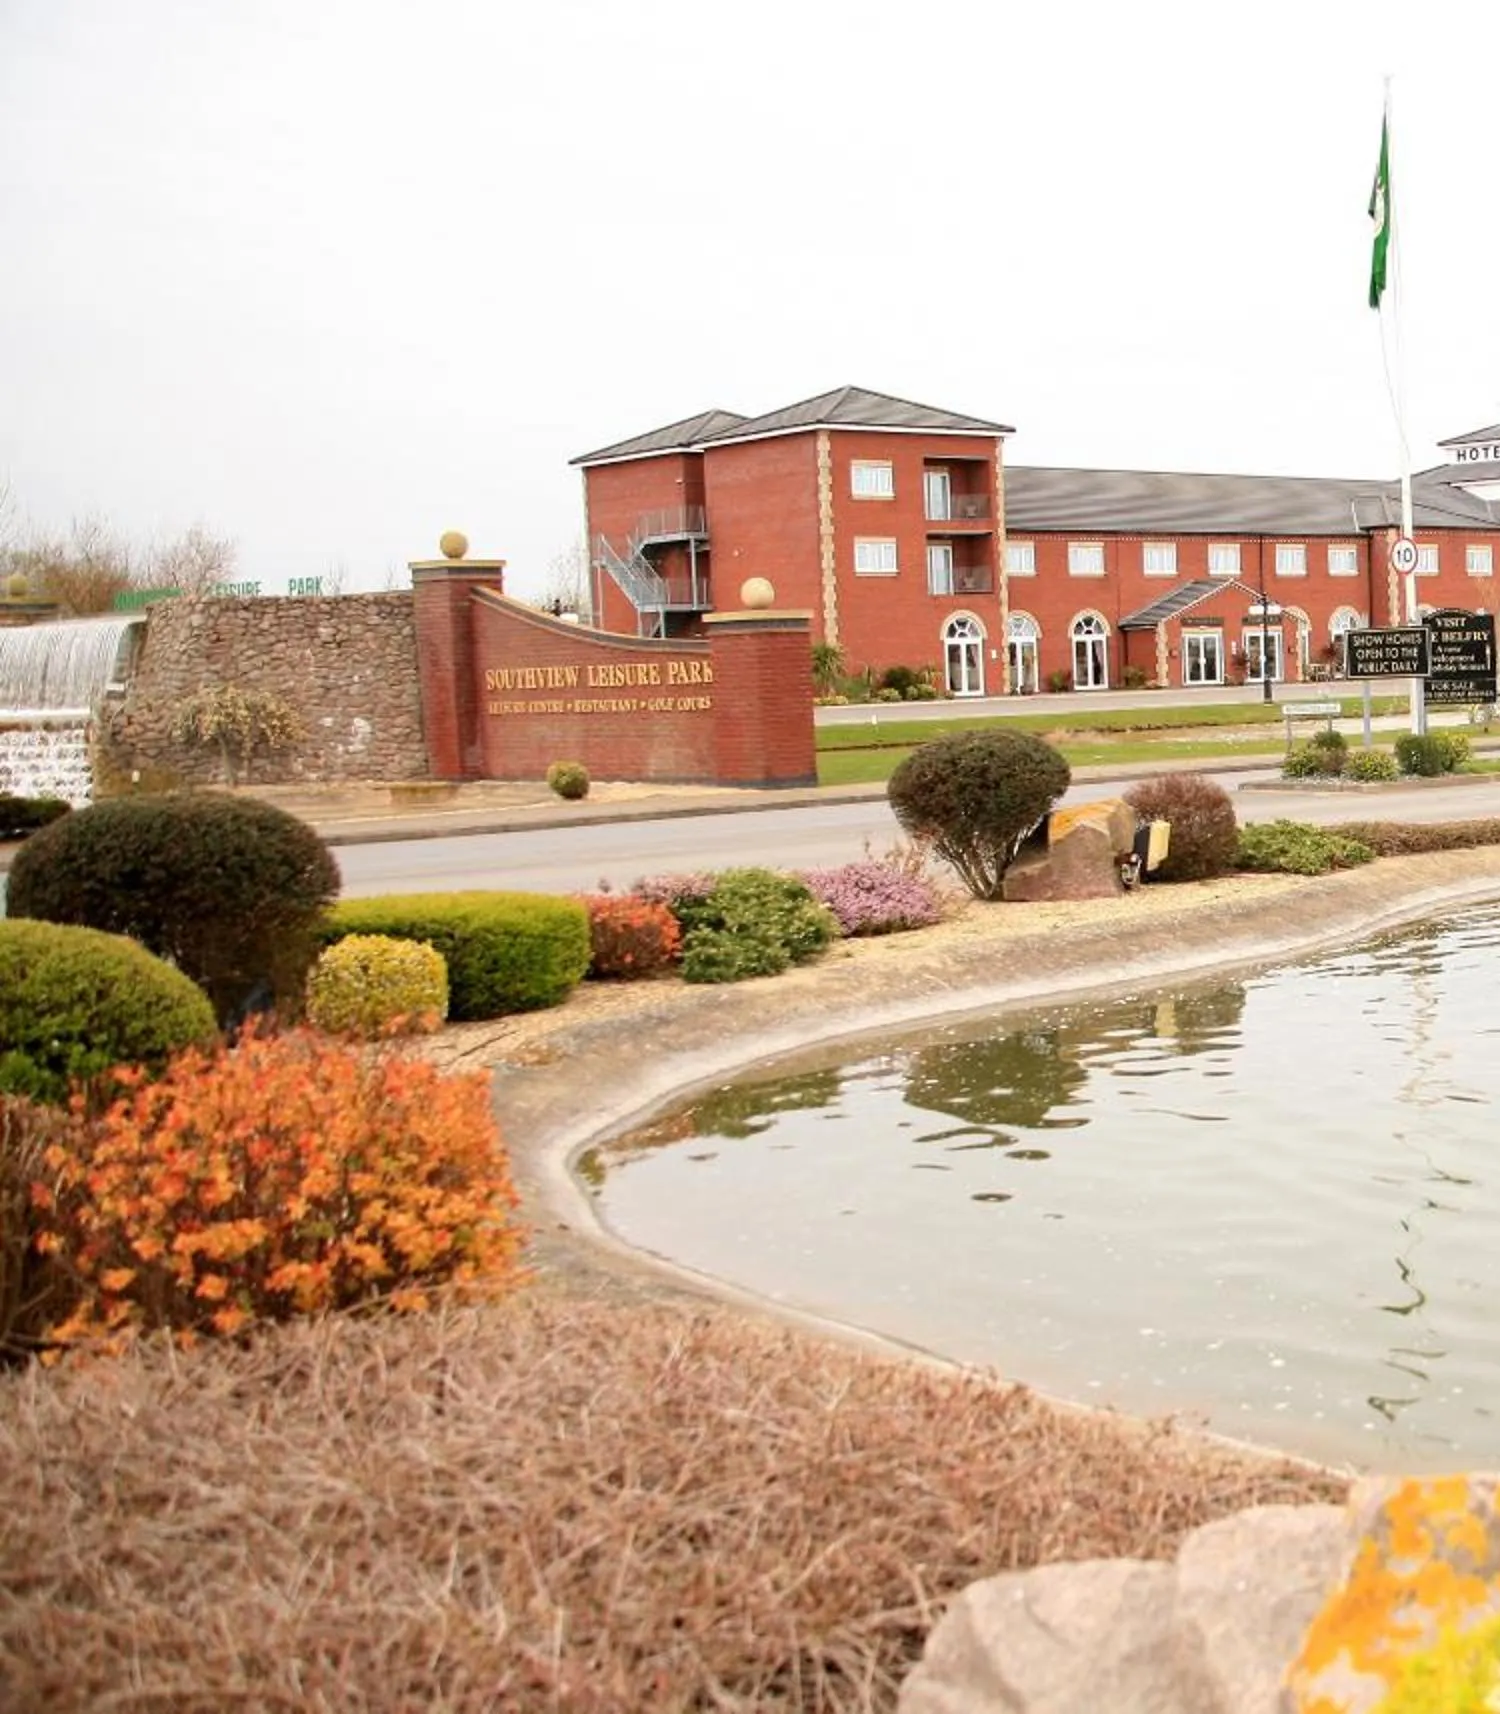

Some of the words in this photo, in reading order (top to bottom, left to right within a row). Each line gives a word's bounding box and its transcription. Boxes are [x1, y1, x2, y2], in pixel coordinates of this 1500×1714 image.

[1397, 547, 1413, 563] 10
[288, 576, 324, 596] PARK
[1435, 617, 1467, 627] VISIT
[1353, 634, 1385, 647] SHOW
[1386, 632, 1422, 645] HOMES
[1441, 631, 1490, 642] BELFRY
[1356, 648, 1383, 660] OPEN
[1385, 647, 1399, 659] TO
[1357, 661, 1389, 673] PUBLIC
[1391, 660, 1418, 672] DAILY
[485, 666, 580, 690] SOUTHVIEW
[587, 663, 661, 687] LEISURE
[667, 661, 714, 685] PARK
